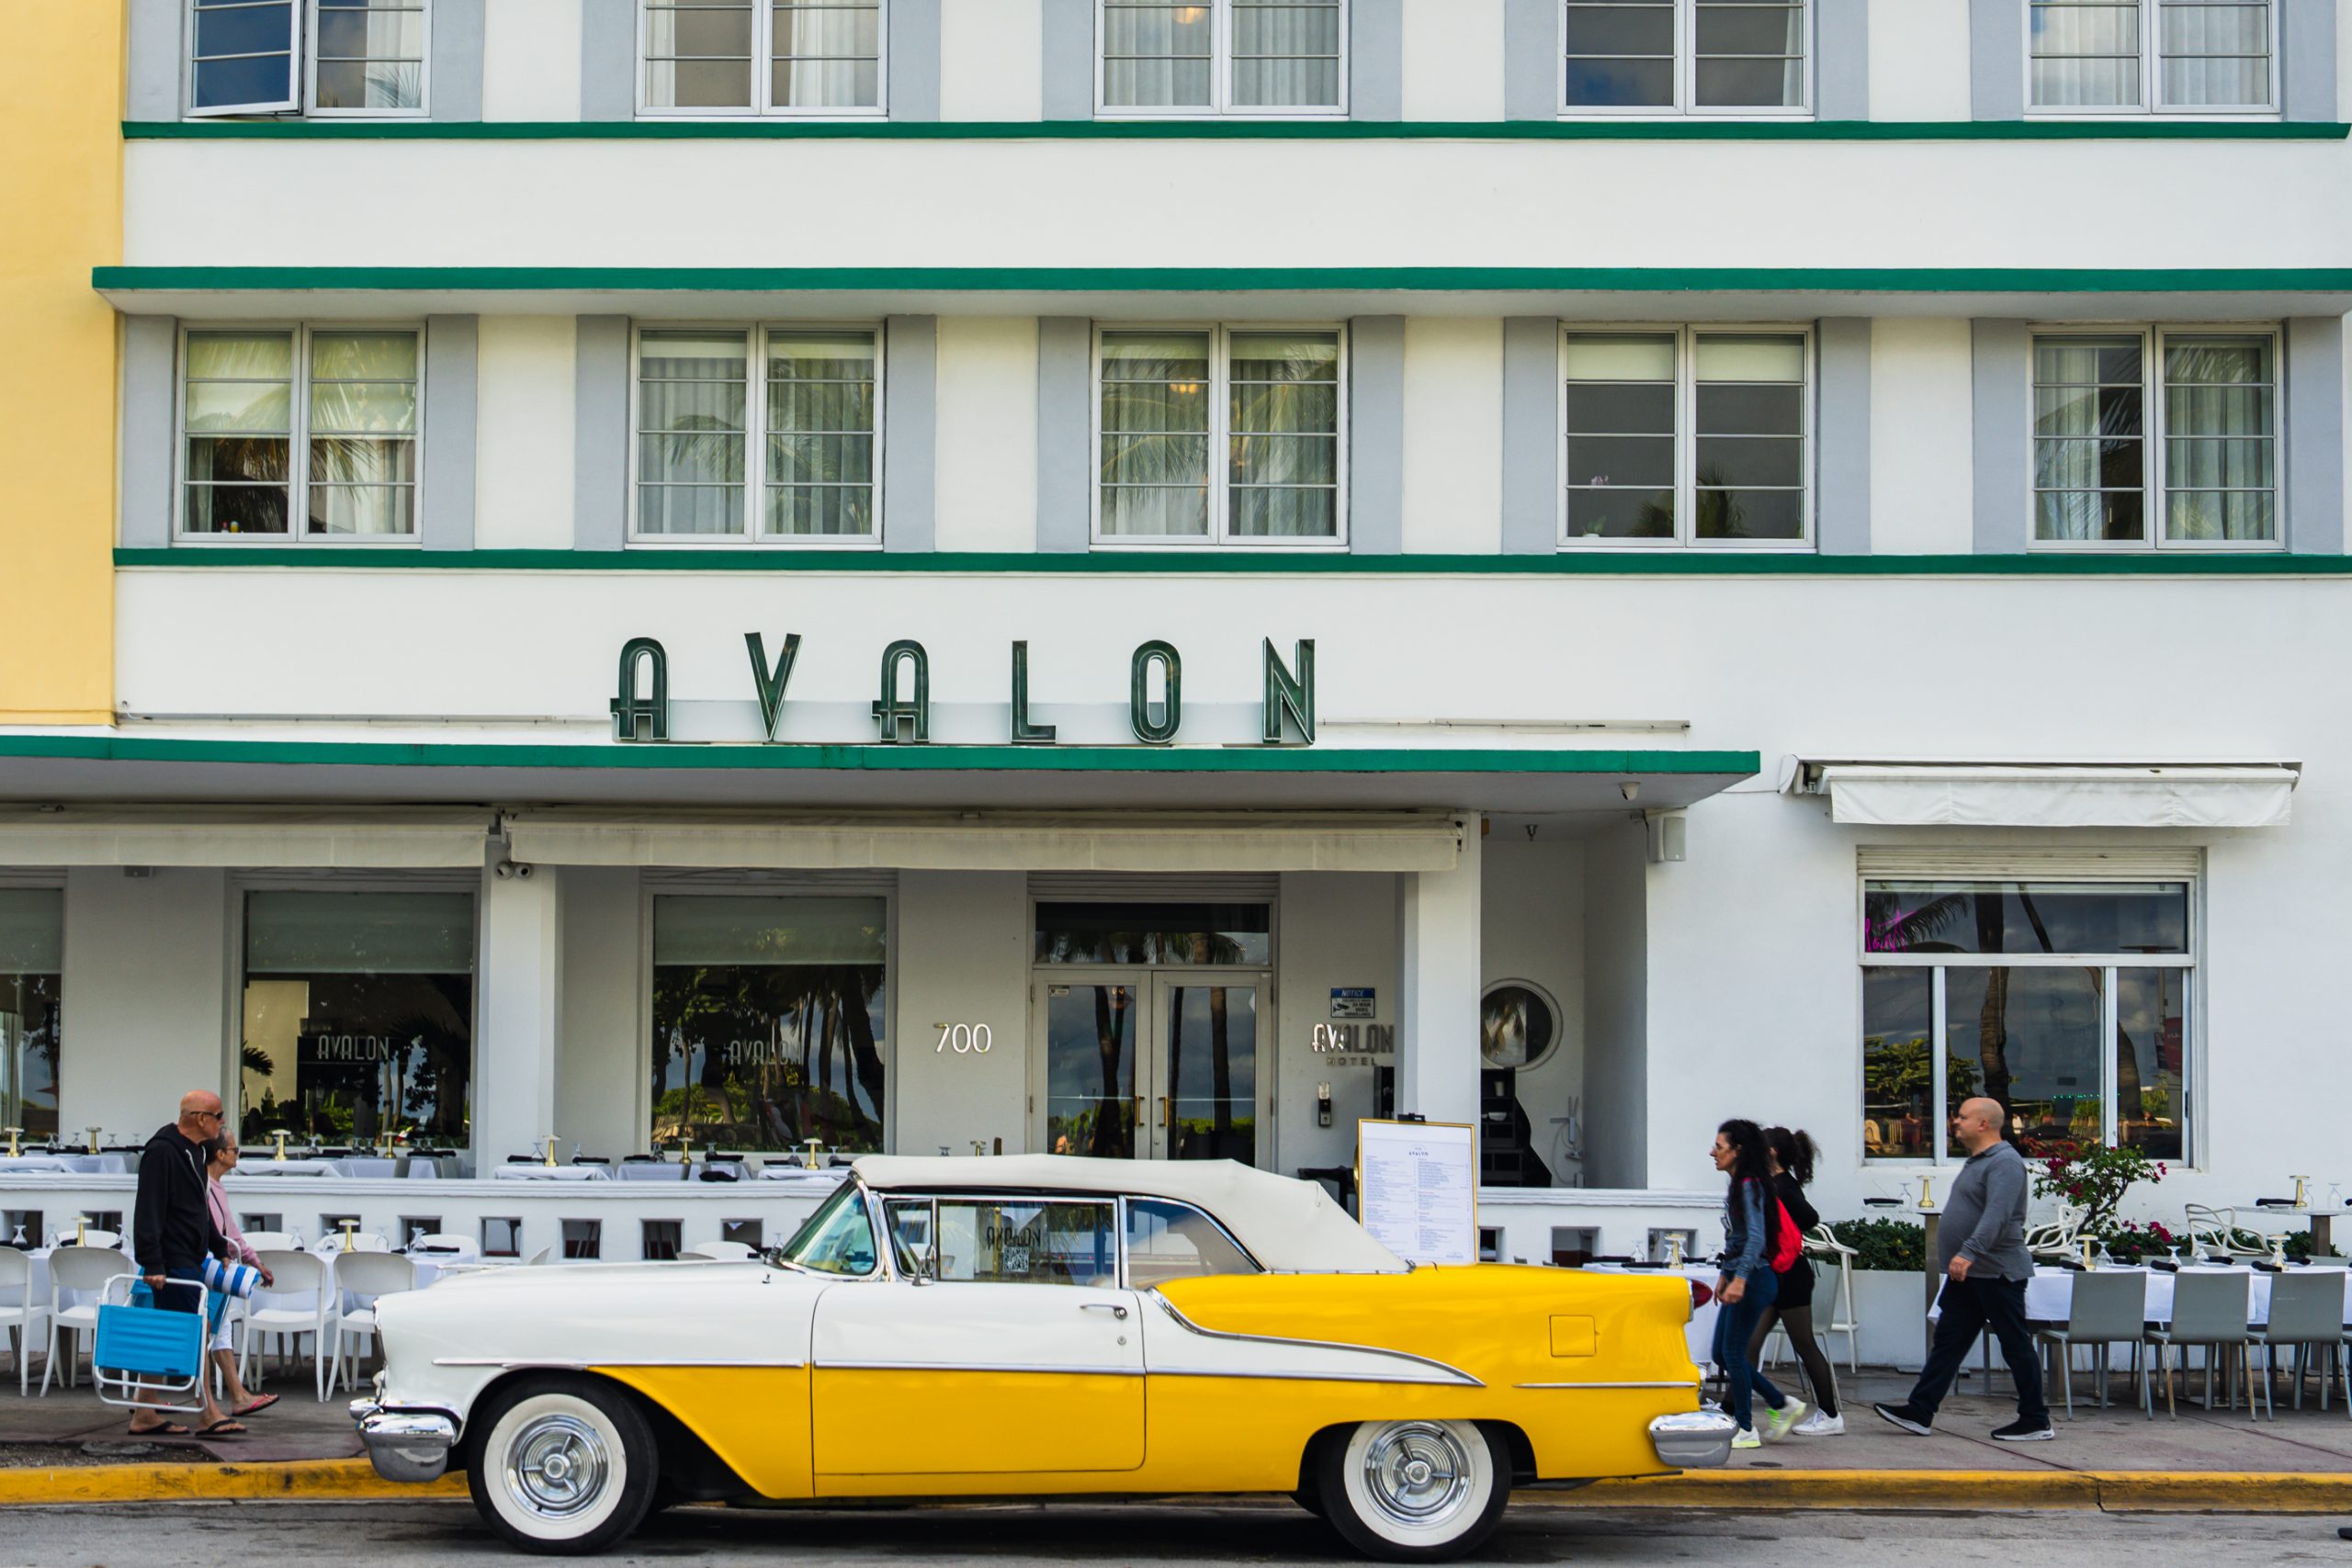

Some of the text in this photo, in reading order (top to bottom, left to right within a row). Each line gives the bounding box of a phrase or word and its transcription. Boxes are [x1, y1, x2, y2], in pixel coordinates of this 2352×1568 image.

[609, 630, 1317, 745] AVALON
[1341, 989, 1364, 998] NOTICE
[317, 1034, 390, 1060] AVALON
[933, 1022, 992, 1054] 700
[1312, 1023, 1395, 1054] AVALON
[1327, 1056, 1378, 1066] HOTEL
